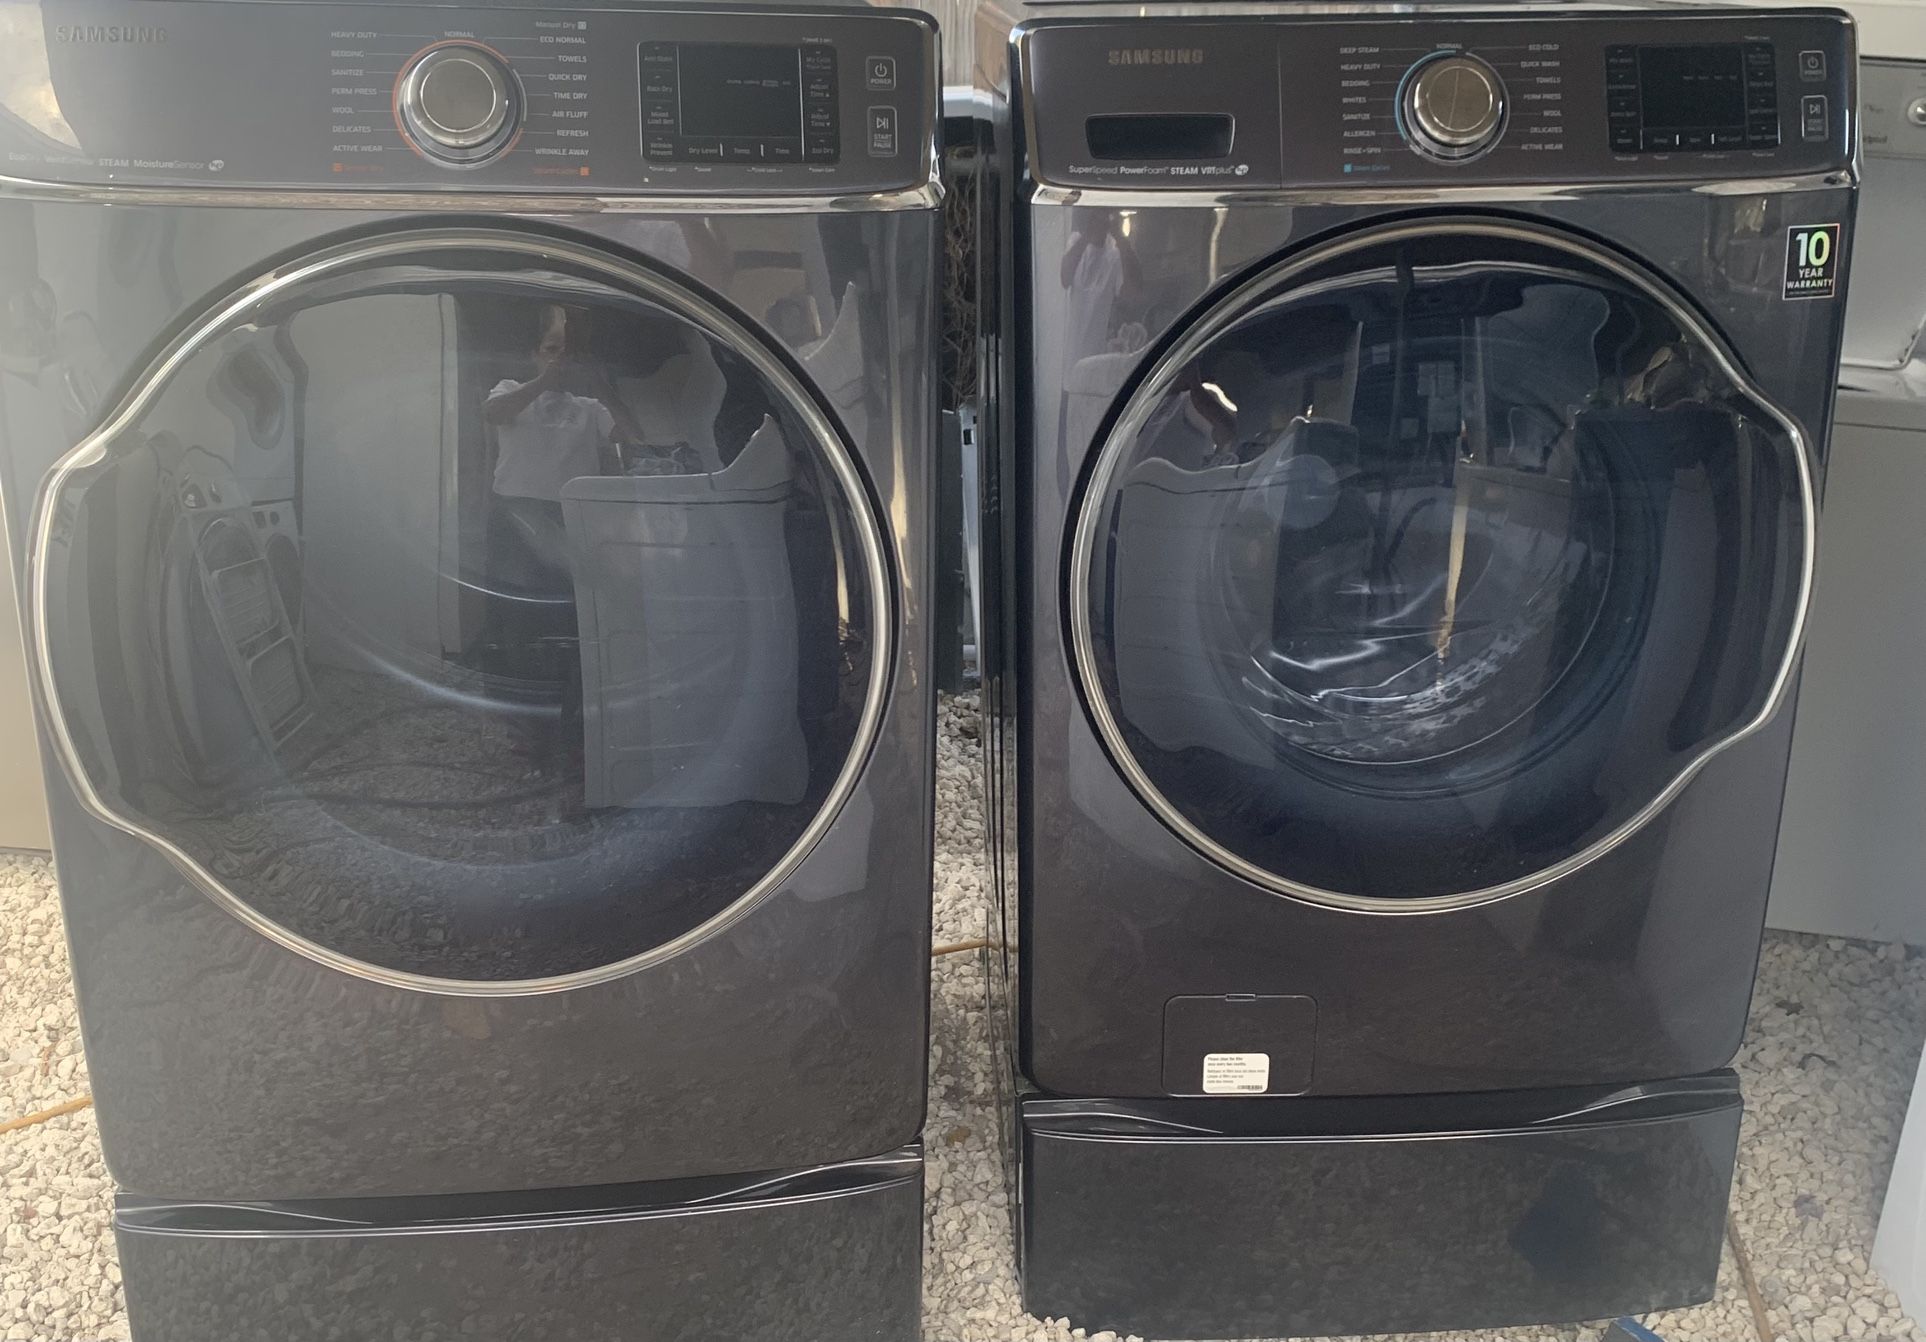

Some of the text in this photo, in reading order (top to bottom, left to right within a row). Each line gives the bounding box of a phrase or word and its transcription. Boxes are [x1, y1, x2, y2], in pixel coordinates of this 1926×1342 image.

[55, 25, 168, 43] SAMSUNG
[556, 36, 586, 44] NORMAL
[558, 55, 587, 63] TOWELS
[1108, 49, 1204, 65] SAMSUNG
[548, 73, 587, 81] QUICK DRY
[331, 87, 377, 95] PERM PRESS
[554, 92, 587, 100] TIME DRY
[332, 106, 354, 114] WOOL
[557, 129, 589, 137] REFRESH
[874, 133, 892, 141] START
[568, 148, 589, 156] AWAY
[98, 158, 129, 168] STEAM
[133, 159, 204, 170] MoistureSensor
[1068, 165, 1117, 175] SuperSpeed
[1170, 167, 1198, 175] STEAM
[1795, 230, 1830, 267] 10
[1798, 267, 1824, 279] YEAR
[1787, 278, 1833, 289] WARRANTY
